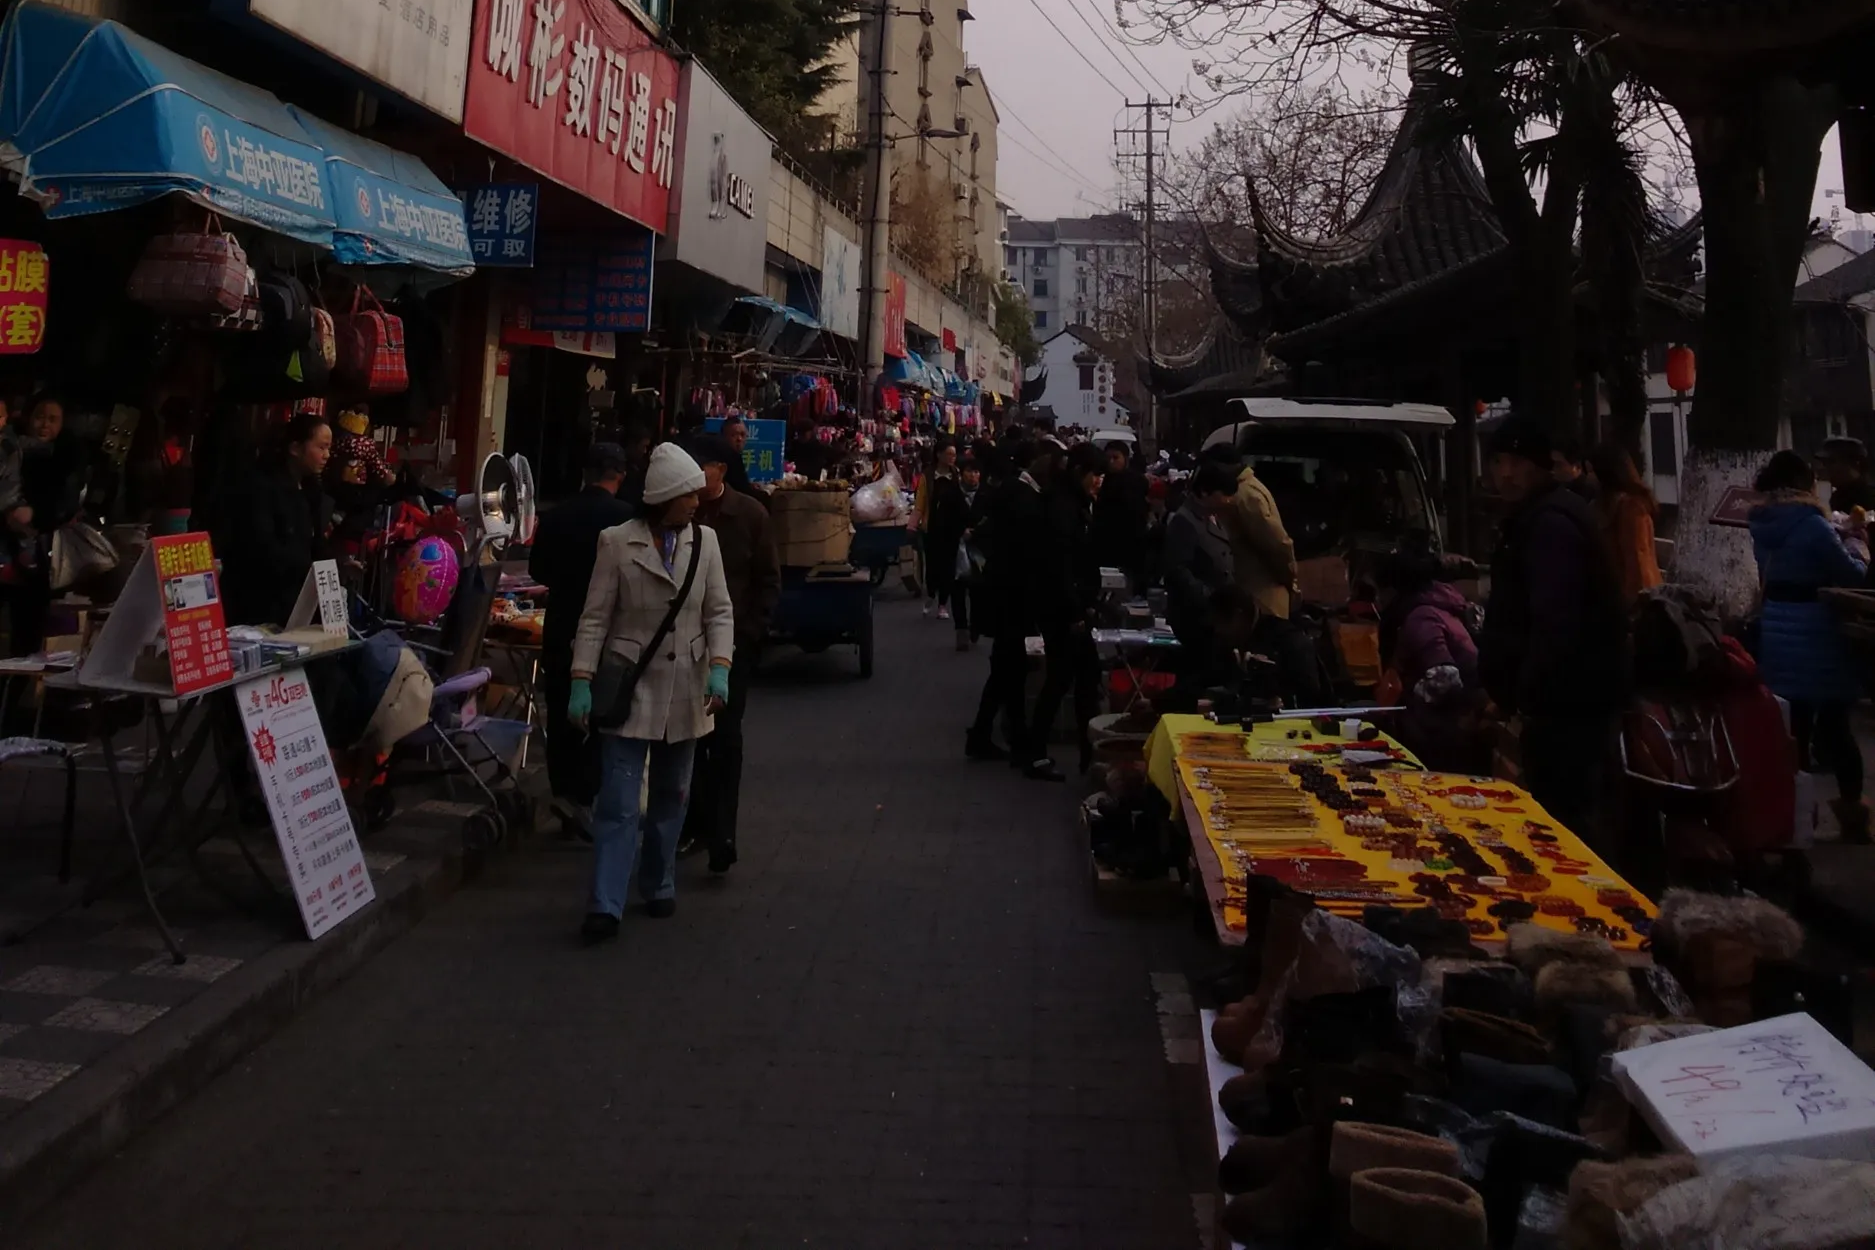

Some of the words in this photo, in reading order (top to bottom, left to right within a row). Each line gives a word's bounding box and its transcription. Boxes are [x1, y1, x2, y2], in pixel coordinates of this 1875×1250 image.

[224, 129, 326, 210] 上海中亚医院
[377, 188, 469, 251] 上海中亚医院
[459, 189, 533, 235] 维修
[728, 174, 755, 220] CAMEL
[473, 239, 526, 258] 可取
[742, 449, 774, 472] 手机
